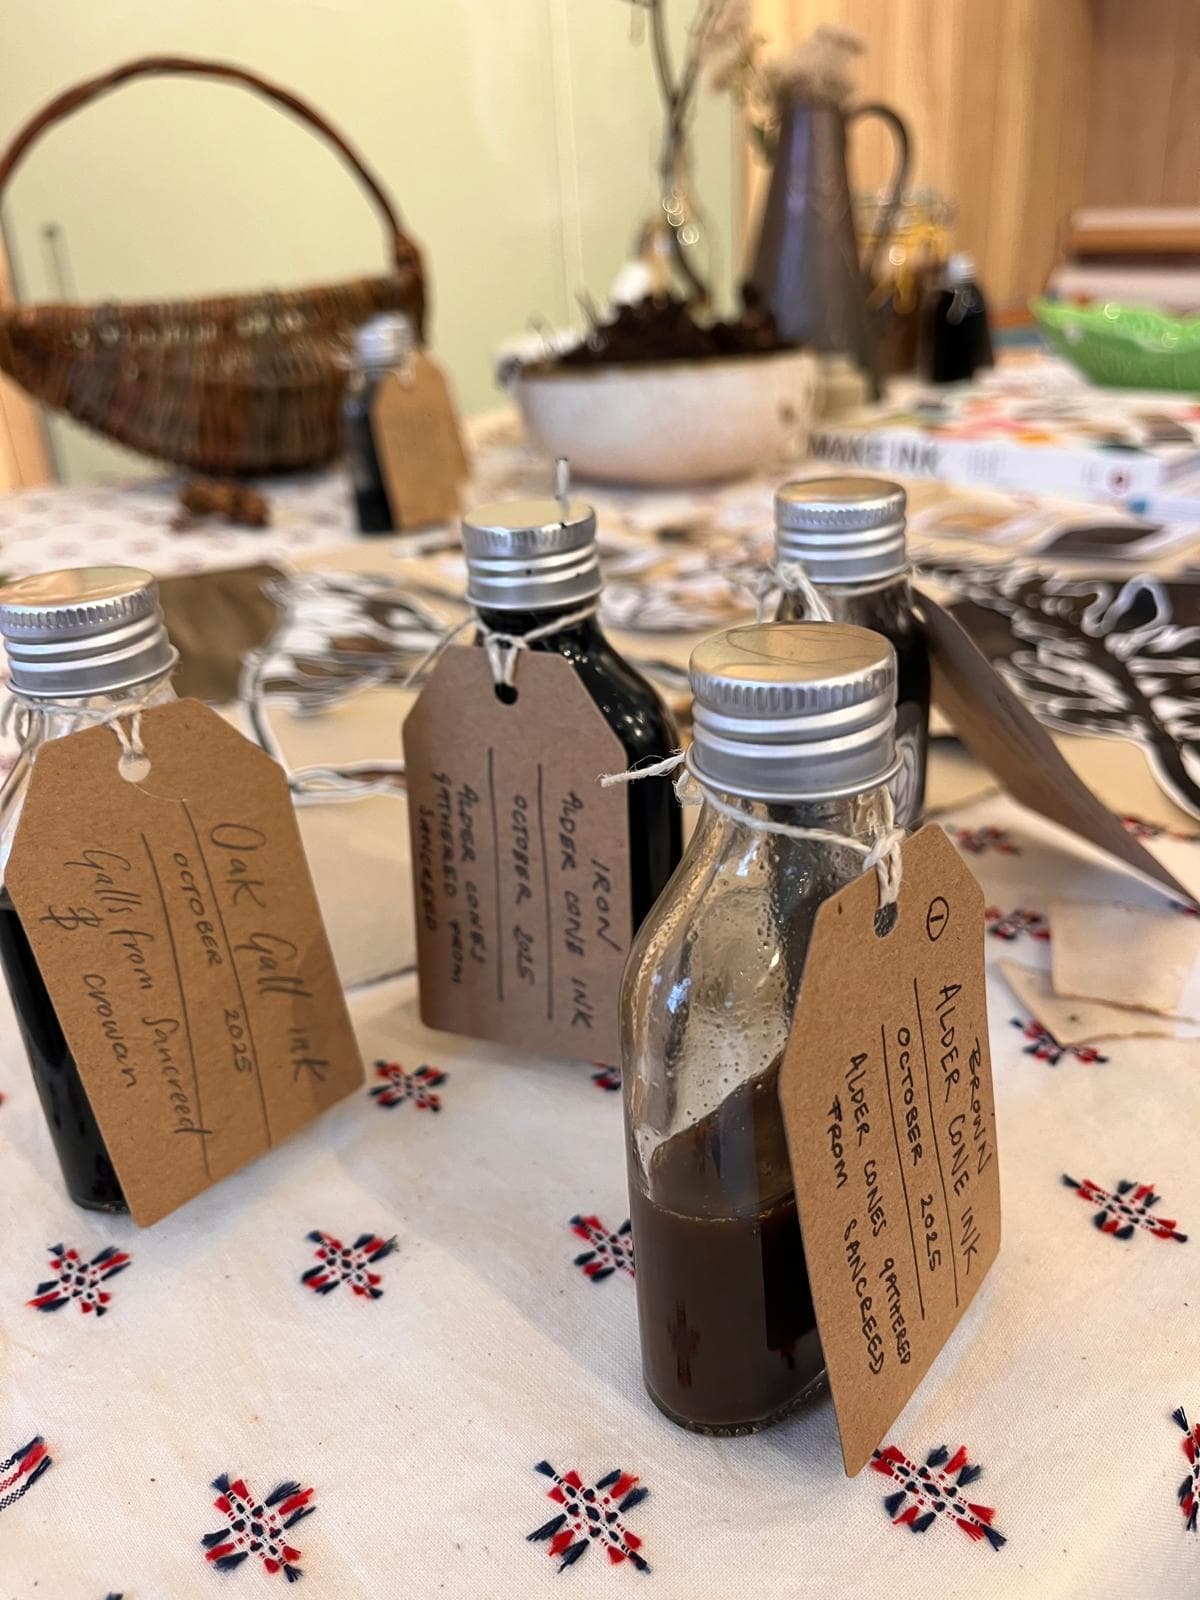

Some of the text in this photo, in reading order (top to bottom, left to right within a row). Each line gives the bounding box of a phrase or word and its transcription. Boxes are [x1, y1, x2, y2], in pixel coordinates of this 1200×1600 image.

[807, 432, 883, 470] MAKE
[888, 443, 940, 477] INK
[419, 805, 438, 932] SANCREED
[449, 921, 464, 984] FROM
[457, 783, 486, 965] ALDER CONES
[511, 795, 535, 985] OCTOBER 2025
[559, 791, 594, 1030] ALDER CONE INK
[591, 857, 622, 952] IRON
[63, 850, 213, 1134] Galls from Sancreed
[173, 852, 252, 1074] OCTOBER 2025
[235, 932, 313, 999] Gall
[845, 1052, 870, 1147] ALDER
[863, 1159, 887, 1237] CONES
[897, 1027, 942, 1271] OCTOBER 2025
[935, 983, 981, 1275] ALDER CONE INK
[968, 1036, 993, 1174] BROWN
[827, 1094, 884, 1375] FROM SANCREED
